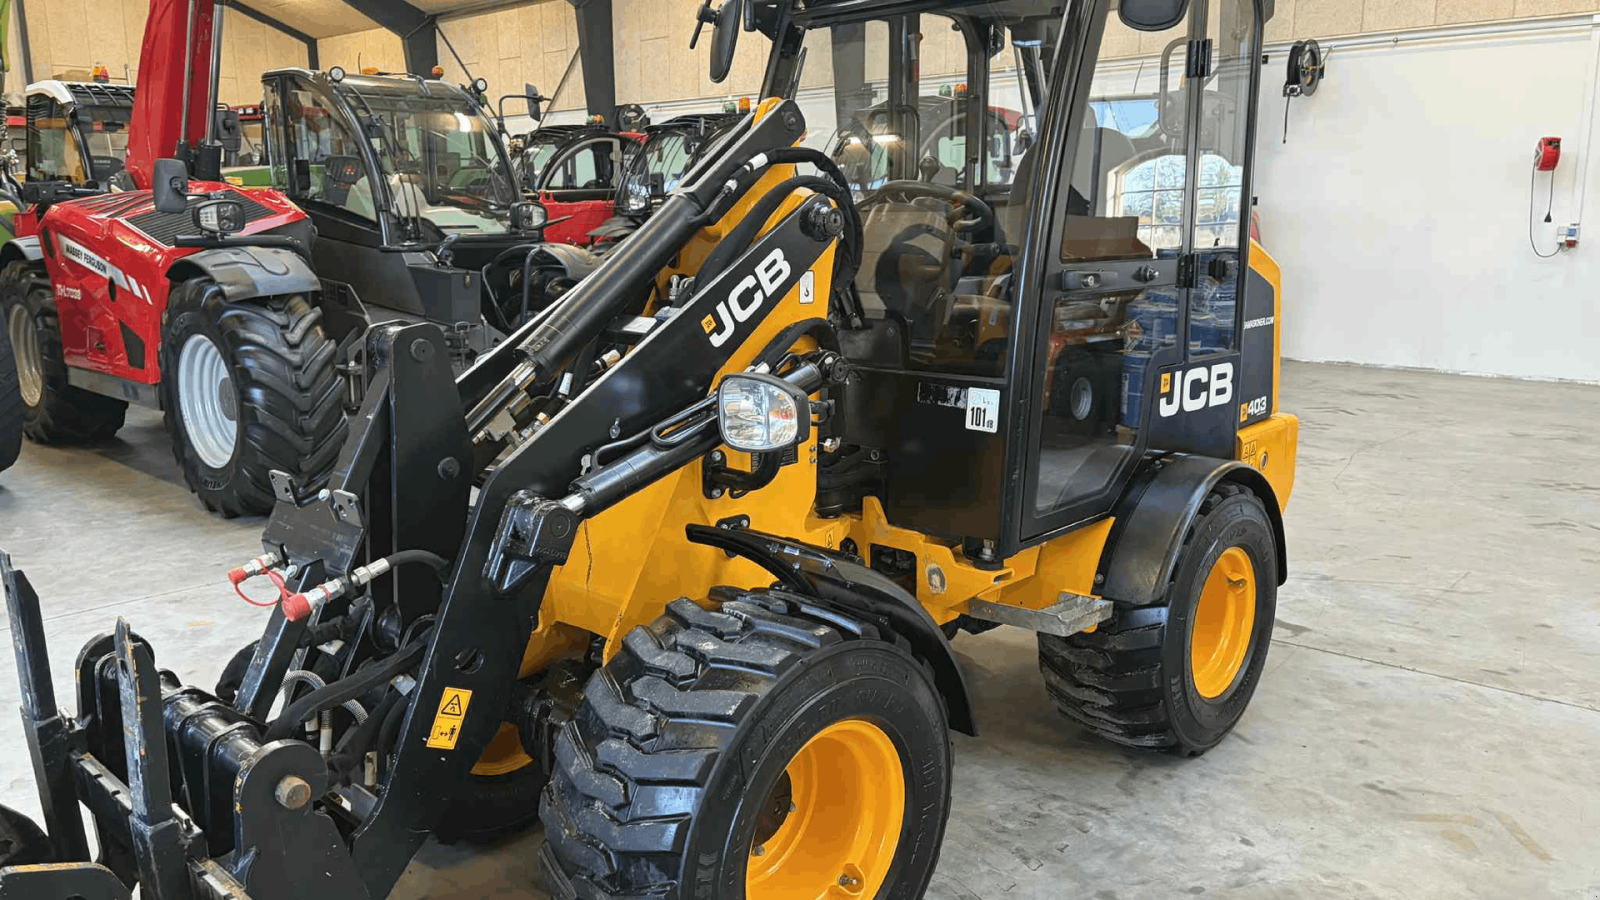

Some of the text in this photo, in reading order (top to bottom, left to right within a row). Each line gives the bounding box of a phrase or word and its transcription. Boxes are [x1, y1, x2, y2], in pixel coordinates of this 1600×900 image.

[66, 244, 107, 274] MASSEY FERGUSON
[708, 247, 791, 348] JCB
[1159, 362, 1234, 418] JCB
[970, 406, 987, 428] 101
[1247, 396, 1267, 415] 403
